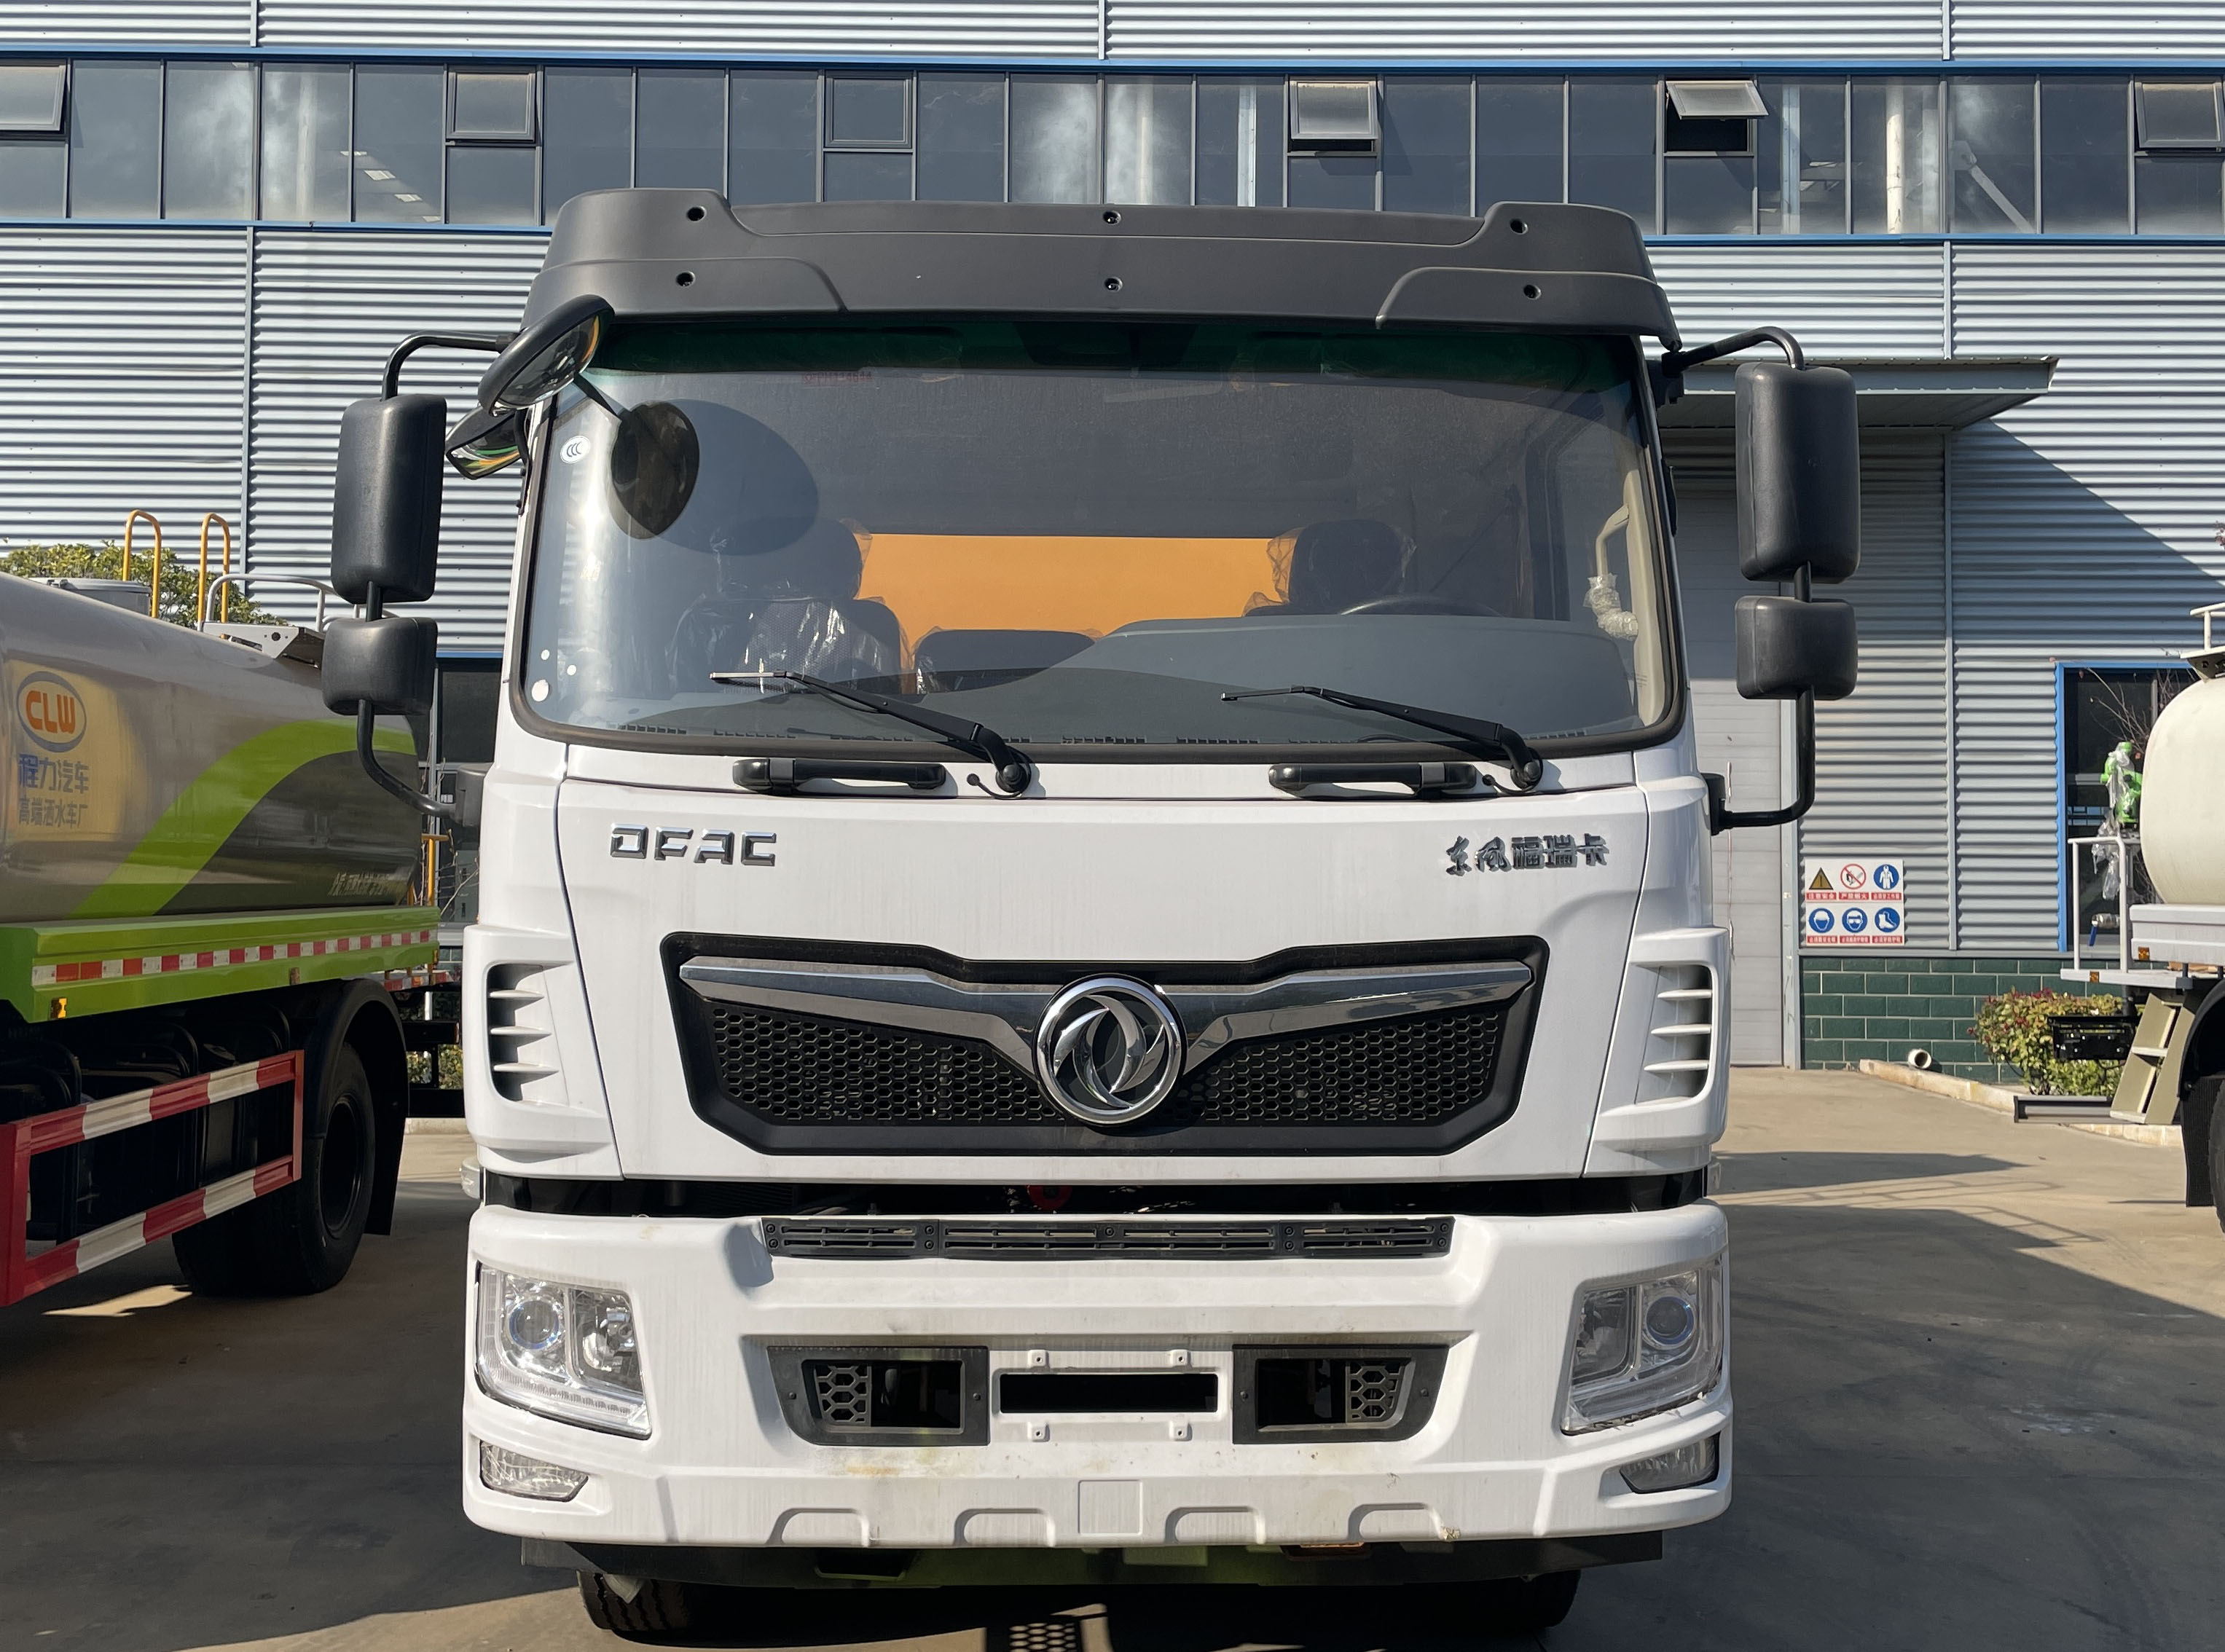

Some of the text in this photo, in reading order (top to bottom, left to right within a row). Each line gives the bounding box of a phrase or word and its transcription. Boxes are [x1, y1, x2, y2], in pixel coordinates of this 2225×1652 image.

[25, 690, 76, 734] CLW
[17, 753, 90, 794] 程力汽车
[18, 795, 89, 829] 高端洒水车厂
[610, 822, 777, 867] DFAC
[1445, 833, 1609, 877] 东风福瑞卡
